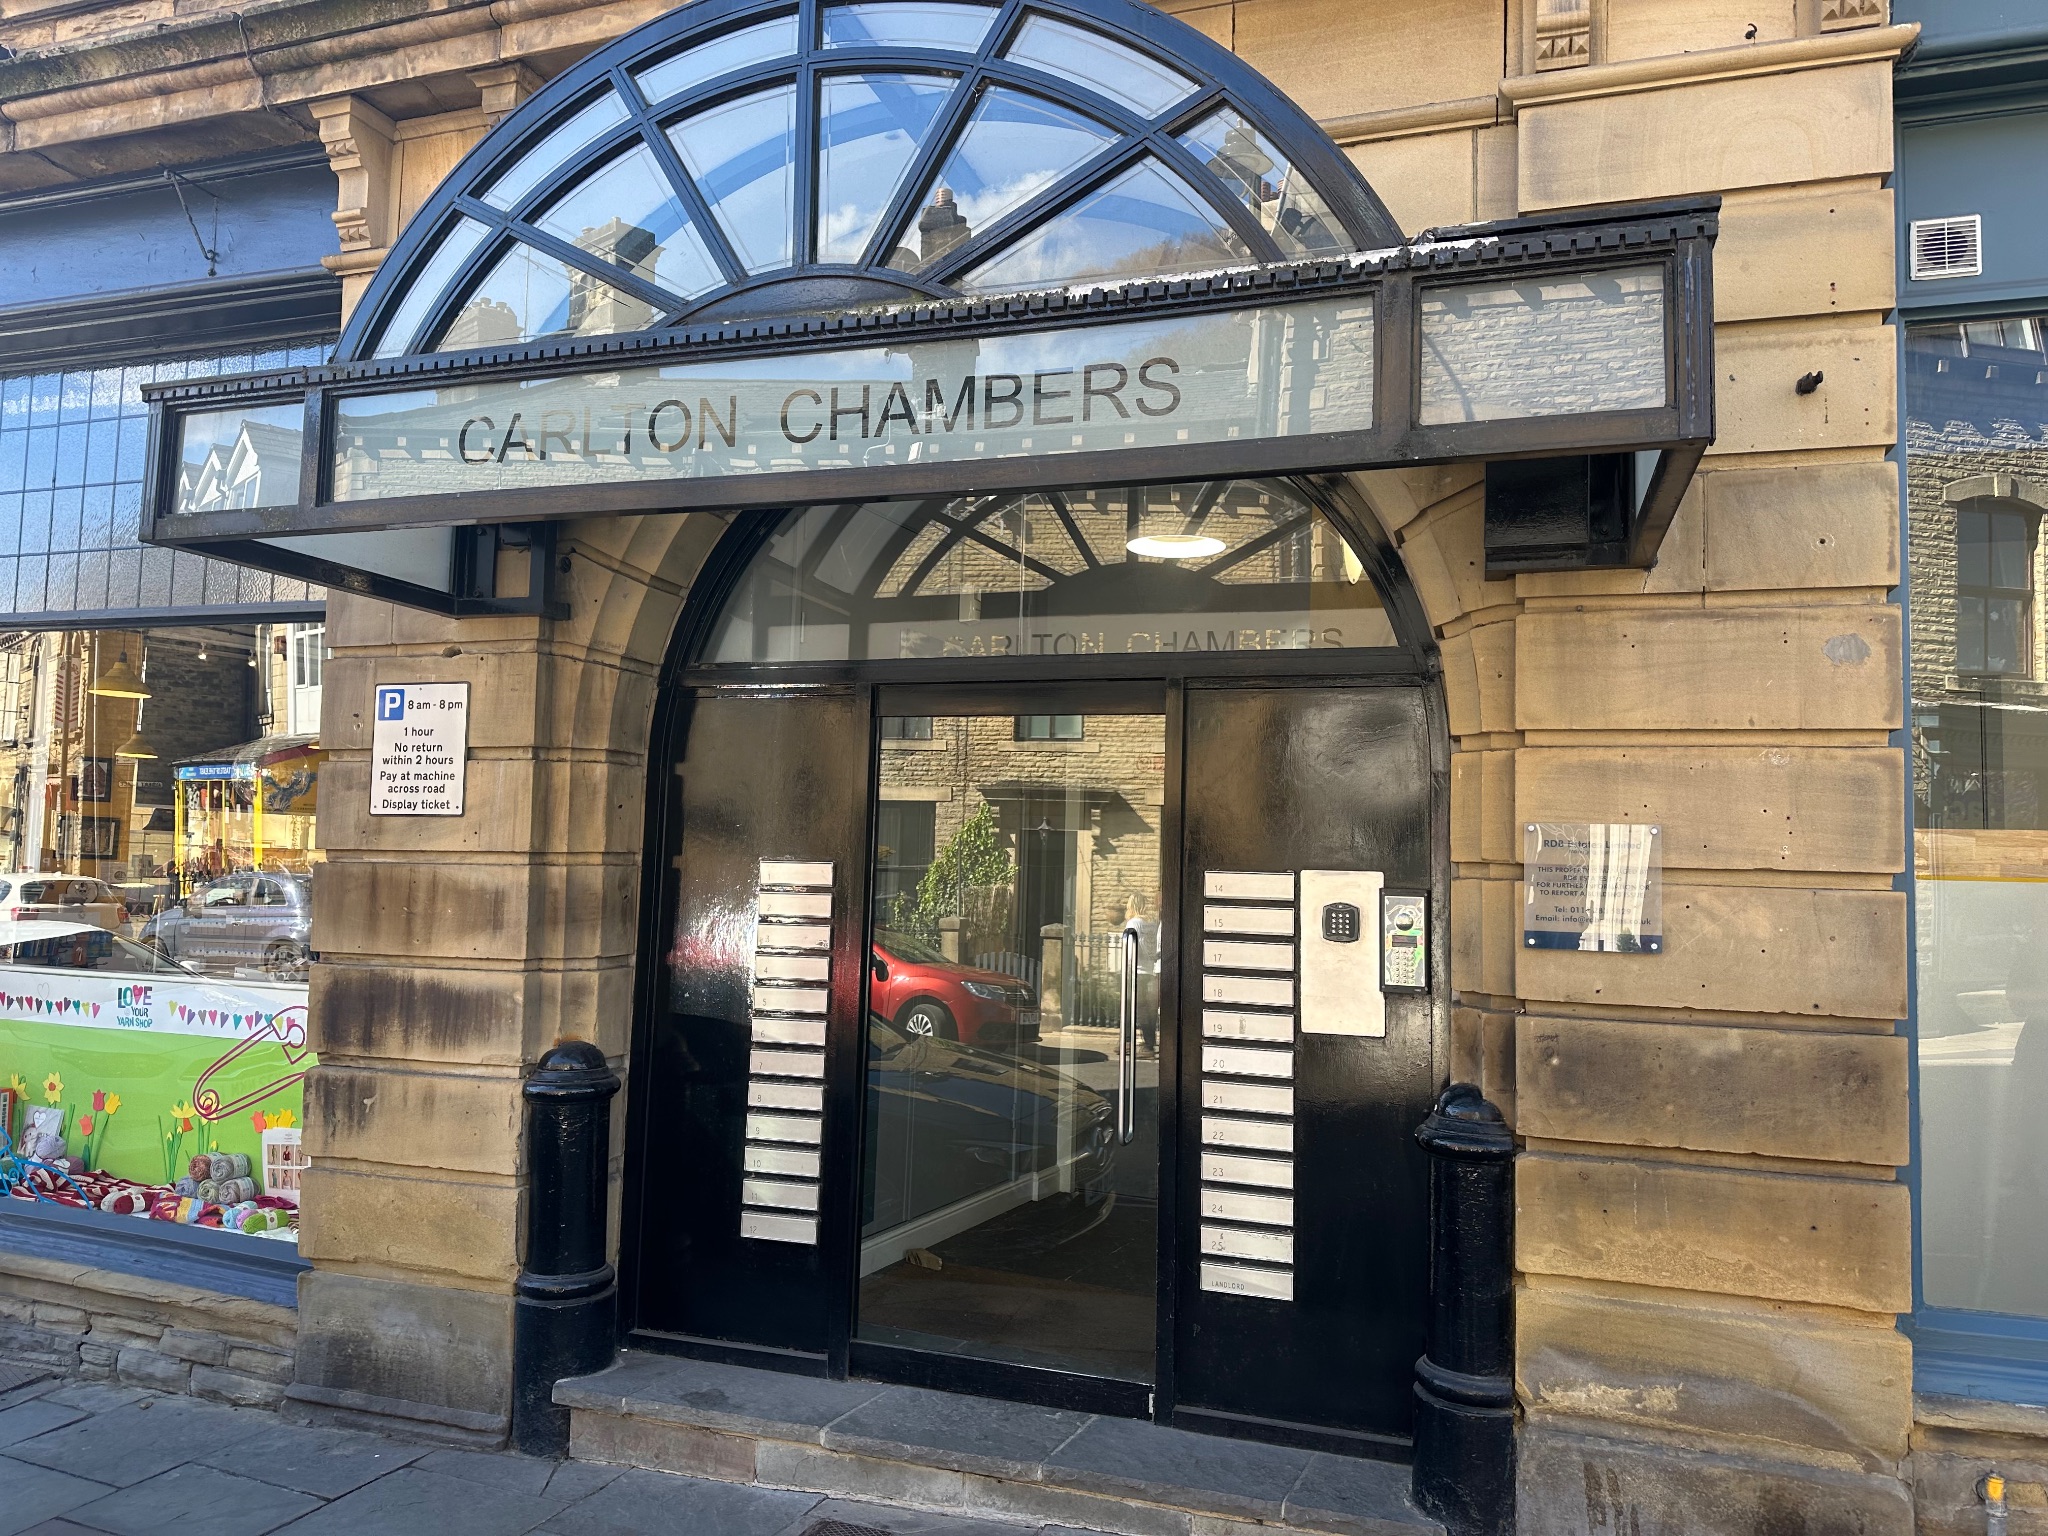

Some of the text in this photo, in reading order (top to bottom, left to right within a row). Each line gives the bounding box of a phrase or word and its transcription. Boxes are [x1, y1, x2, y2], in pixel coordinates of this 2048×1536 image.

[458, 356, 1182, 465] CARLTON CHAMBERS
[384, 692, 401, 718] P
[408, 700, 414, 710] 8
[416, 702, 431, 710] am
[439, 700, 446, 710] 8
[448, 701, 463, 711] pm
[404, 727, 434, 736] 1 hour
[394, 743, 443, 752] No return
[382, 755, 454, 765] within 2 hours
[380, 771, 456, 782] Pay at machine
[388, 784, 446, 794] across road
[382, 799, 451, 811] Display ticket
[1214, 884, 1223, 893] 14
[1536, 914, 1560, 922] Email:
[1214, 918, 1224, 928] 15
[1213, 954, 1222, 962] 17
[1213, 988, 1222, 998] 18
[131, 1006, 148, 1018] YOUR
[116, 1016, 153, 1028] YARN SHOP
[1213, 1024, 1222, 1032] 19
[1212, 1059, 1224, 1068] 20
[1213, 1095, 1223, 1104] 21
[1212, 1131, 1224, 1140] 22
[1212, 1168, 1224, 1177] 23
[1212, 1204, 1224, 1213] 24
